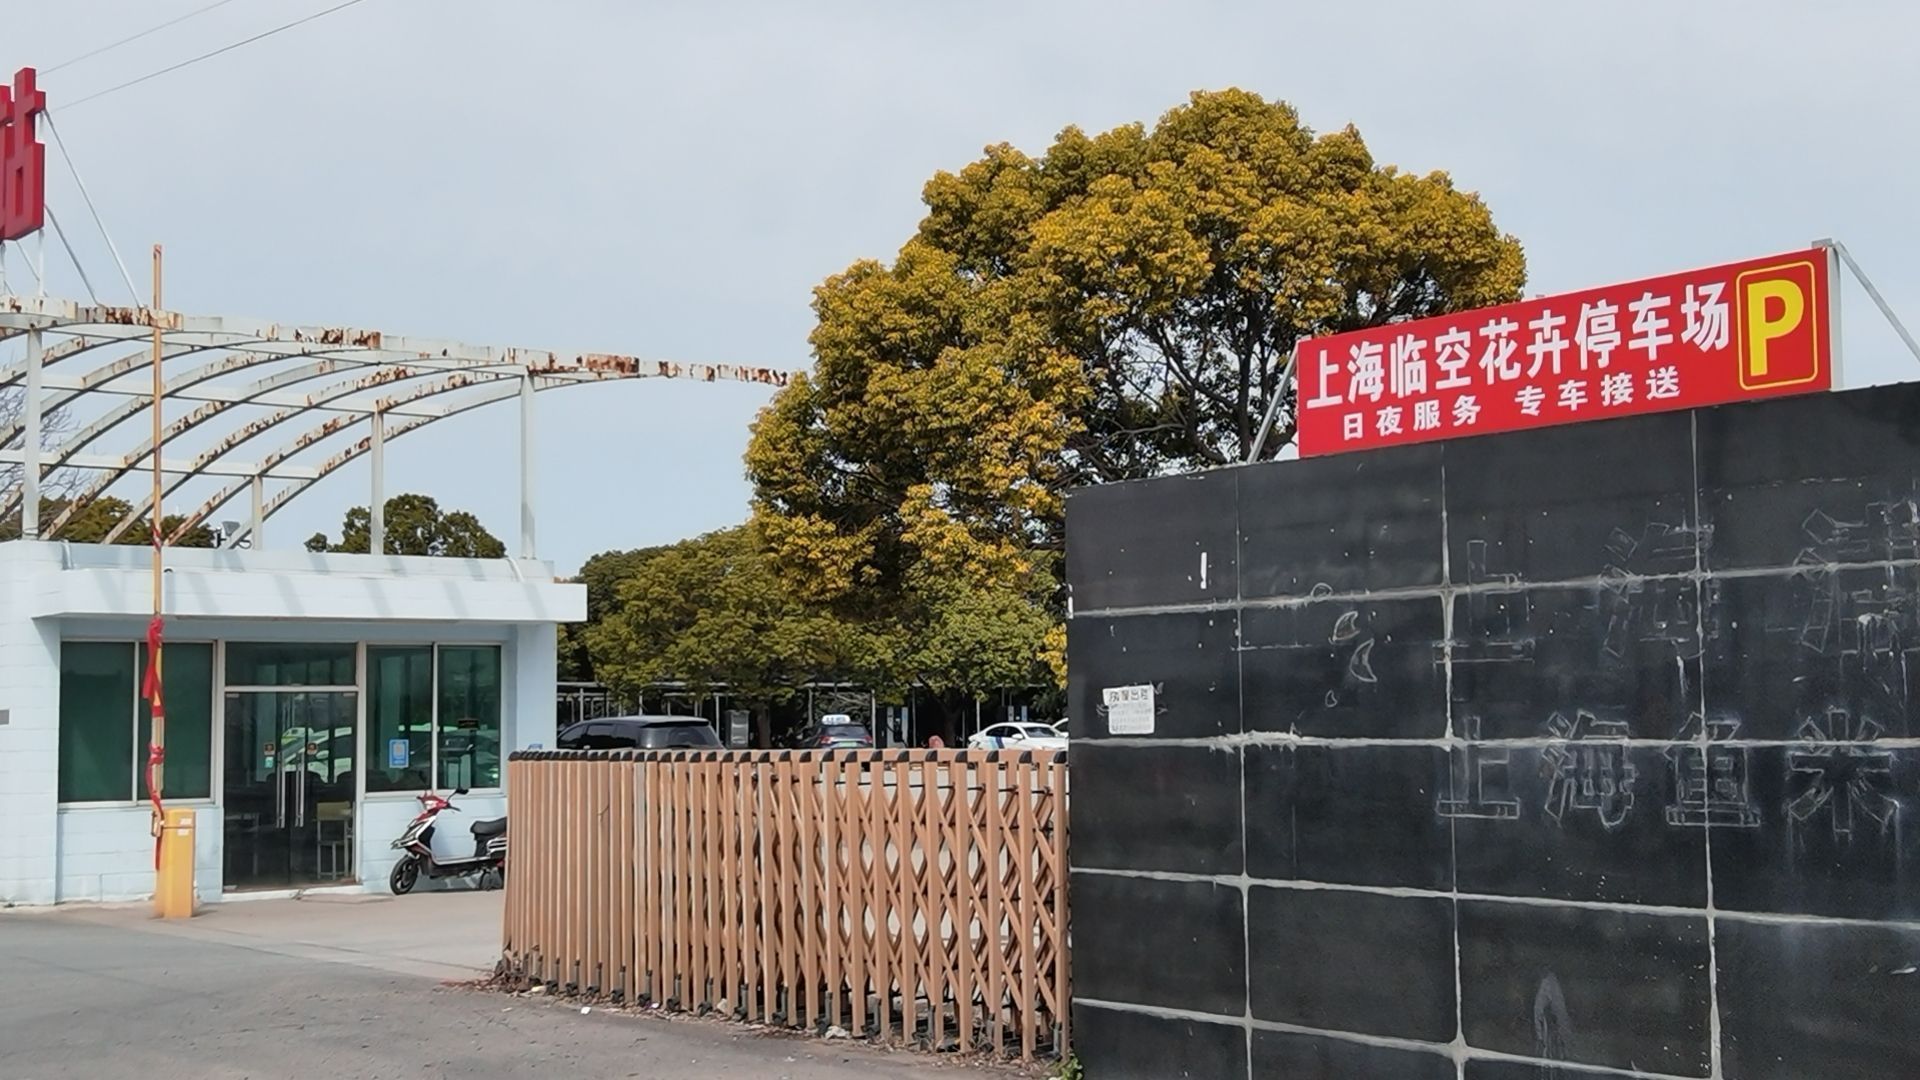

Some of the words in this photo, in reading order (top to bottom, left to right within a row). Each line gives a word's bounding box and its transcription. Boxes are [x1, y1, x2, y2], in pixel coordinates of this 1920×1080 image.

[1306, 281, 1730, 409] 上海临空花卉停车场
[1747, 279, 1804, 376] P
[1343, 394, 1481, 440] 日夜服务
[1515, 366, 1681, 417] 专车接送
